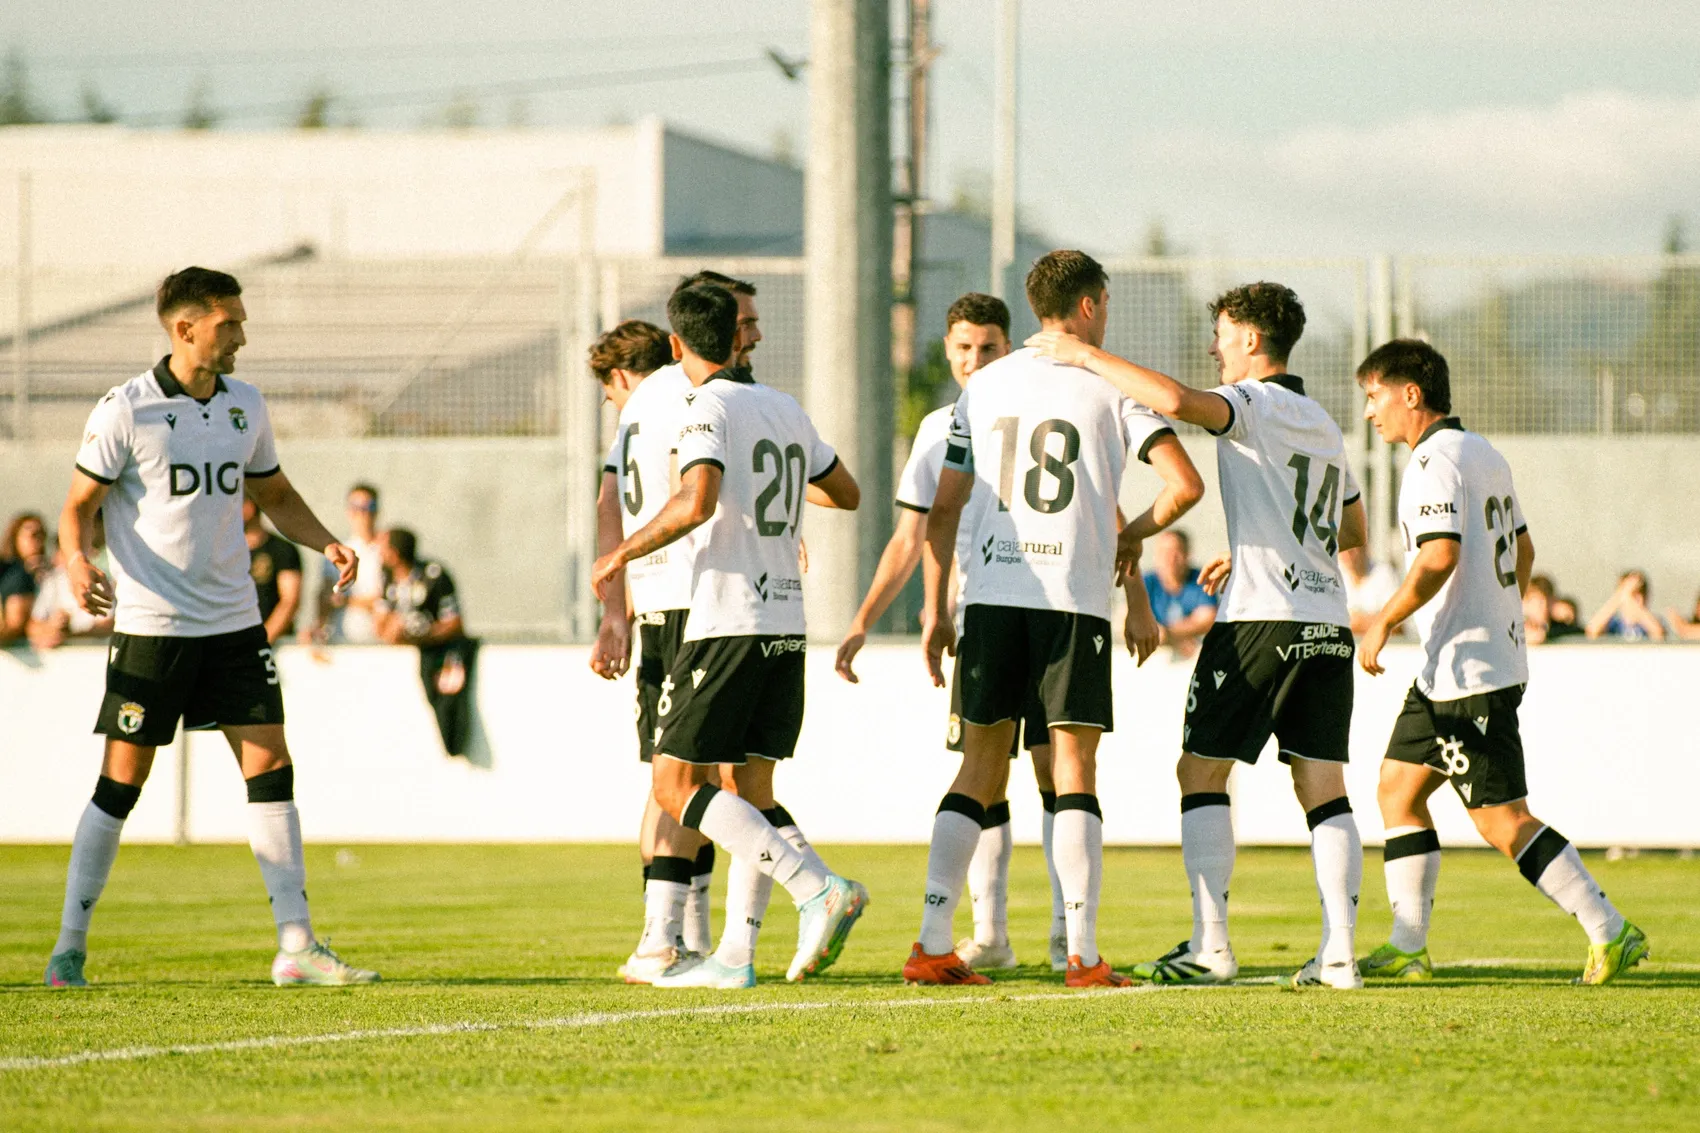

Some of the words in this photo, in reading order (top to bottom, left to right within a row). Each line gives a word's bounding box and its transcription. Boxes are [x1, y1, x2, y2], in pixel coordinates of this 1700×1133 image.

[753, 439, 806, 538] 20
[992, 416, 1080, 514] 18
[1287, 453, 1340, 557] 14
[1301, 624, 1340, 640] EXIDE
